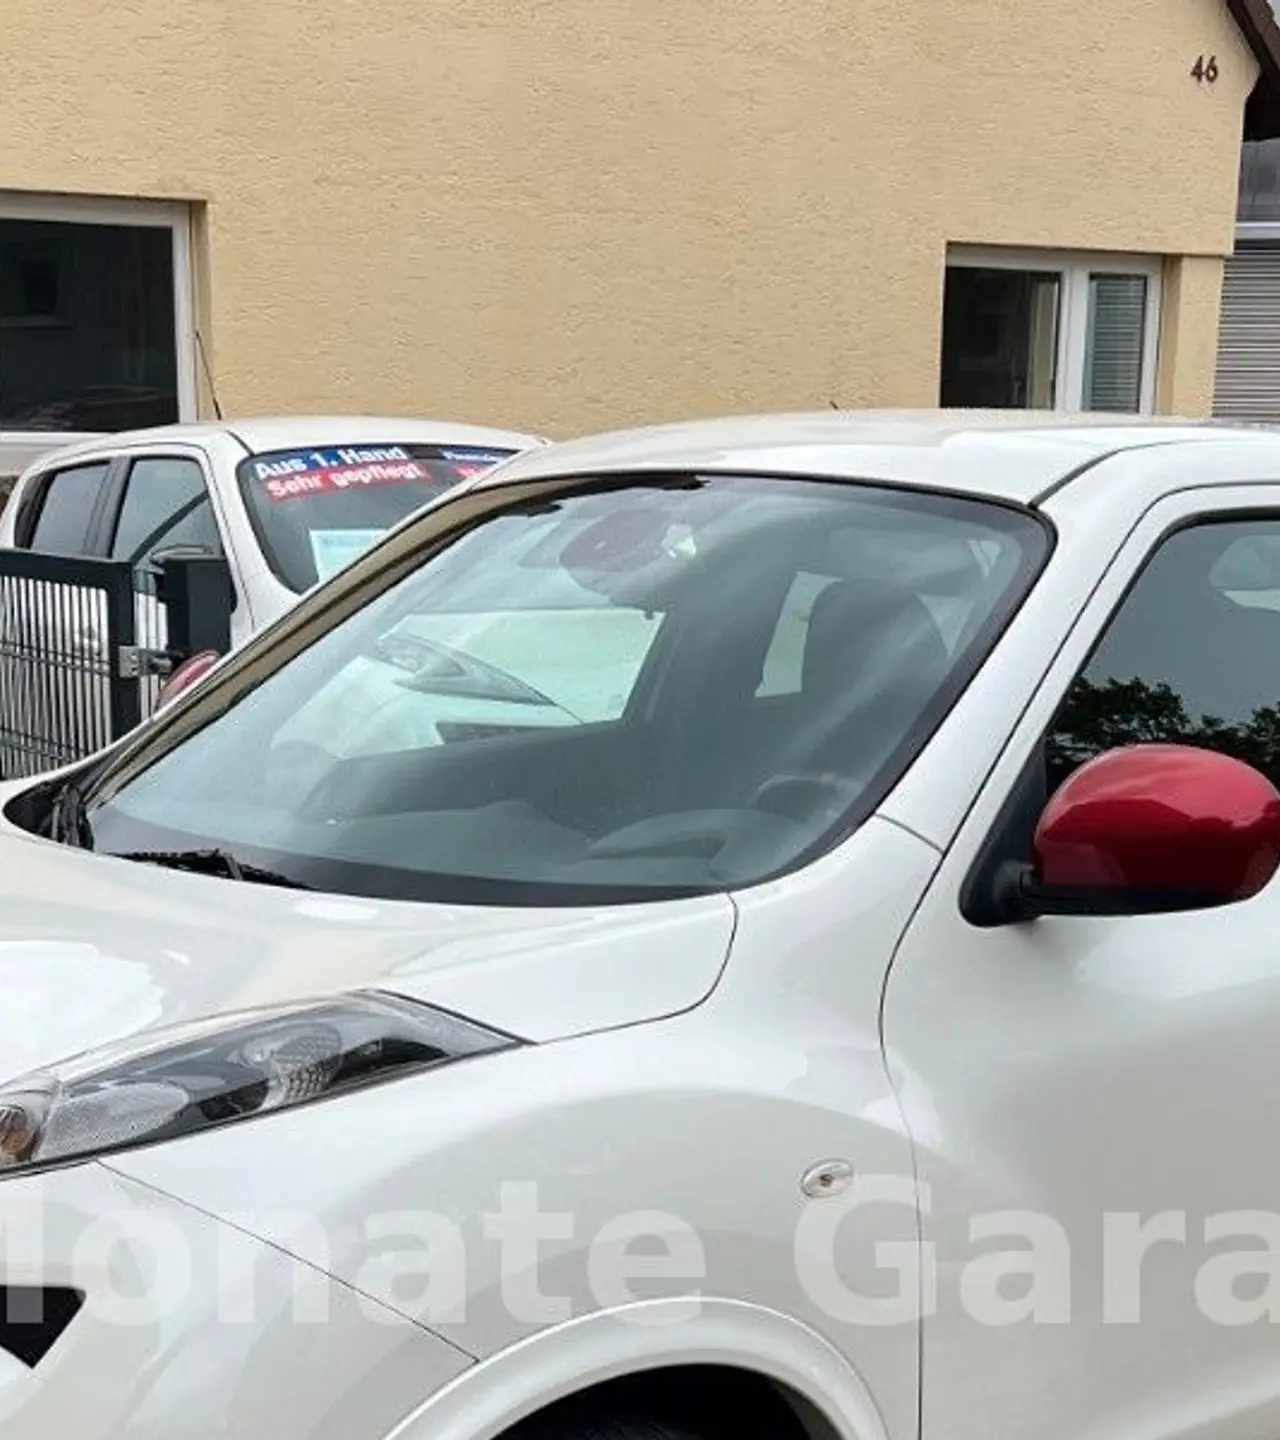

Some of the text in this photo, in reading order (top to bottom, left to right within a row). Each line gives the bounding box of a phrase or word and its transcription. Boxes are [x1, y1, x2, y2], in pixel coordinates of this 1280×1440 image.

[1190, 55, 1218, 83] 46
[254, 446, 408, 480] Aus 1. Hand
[267, 471, 323, 497] Sehr
[330, 462, 423, 489] gepflegt
